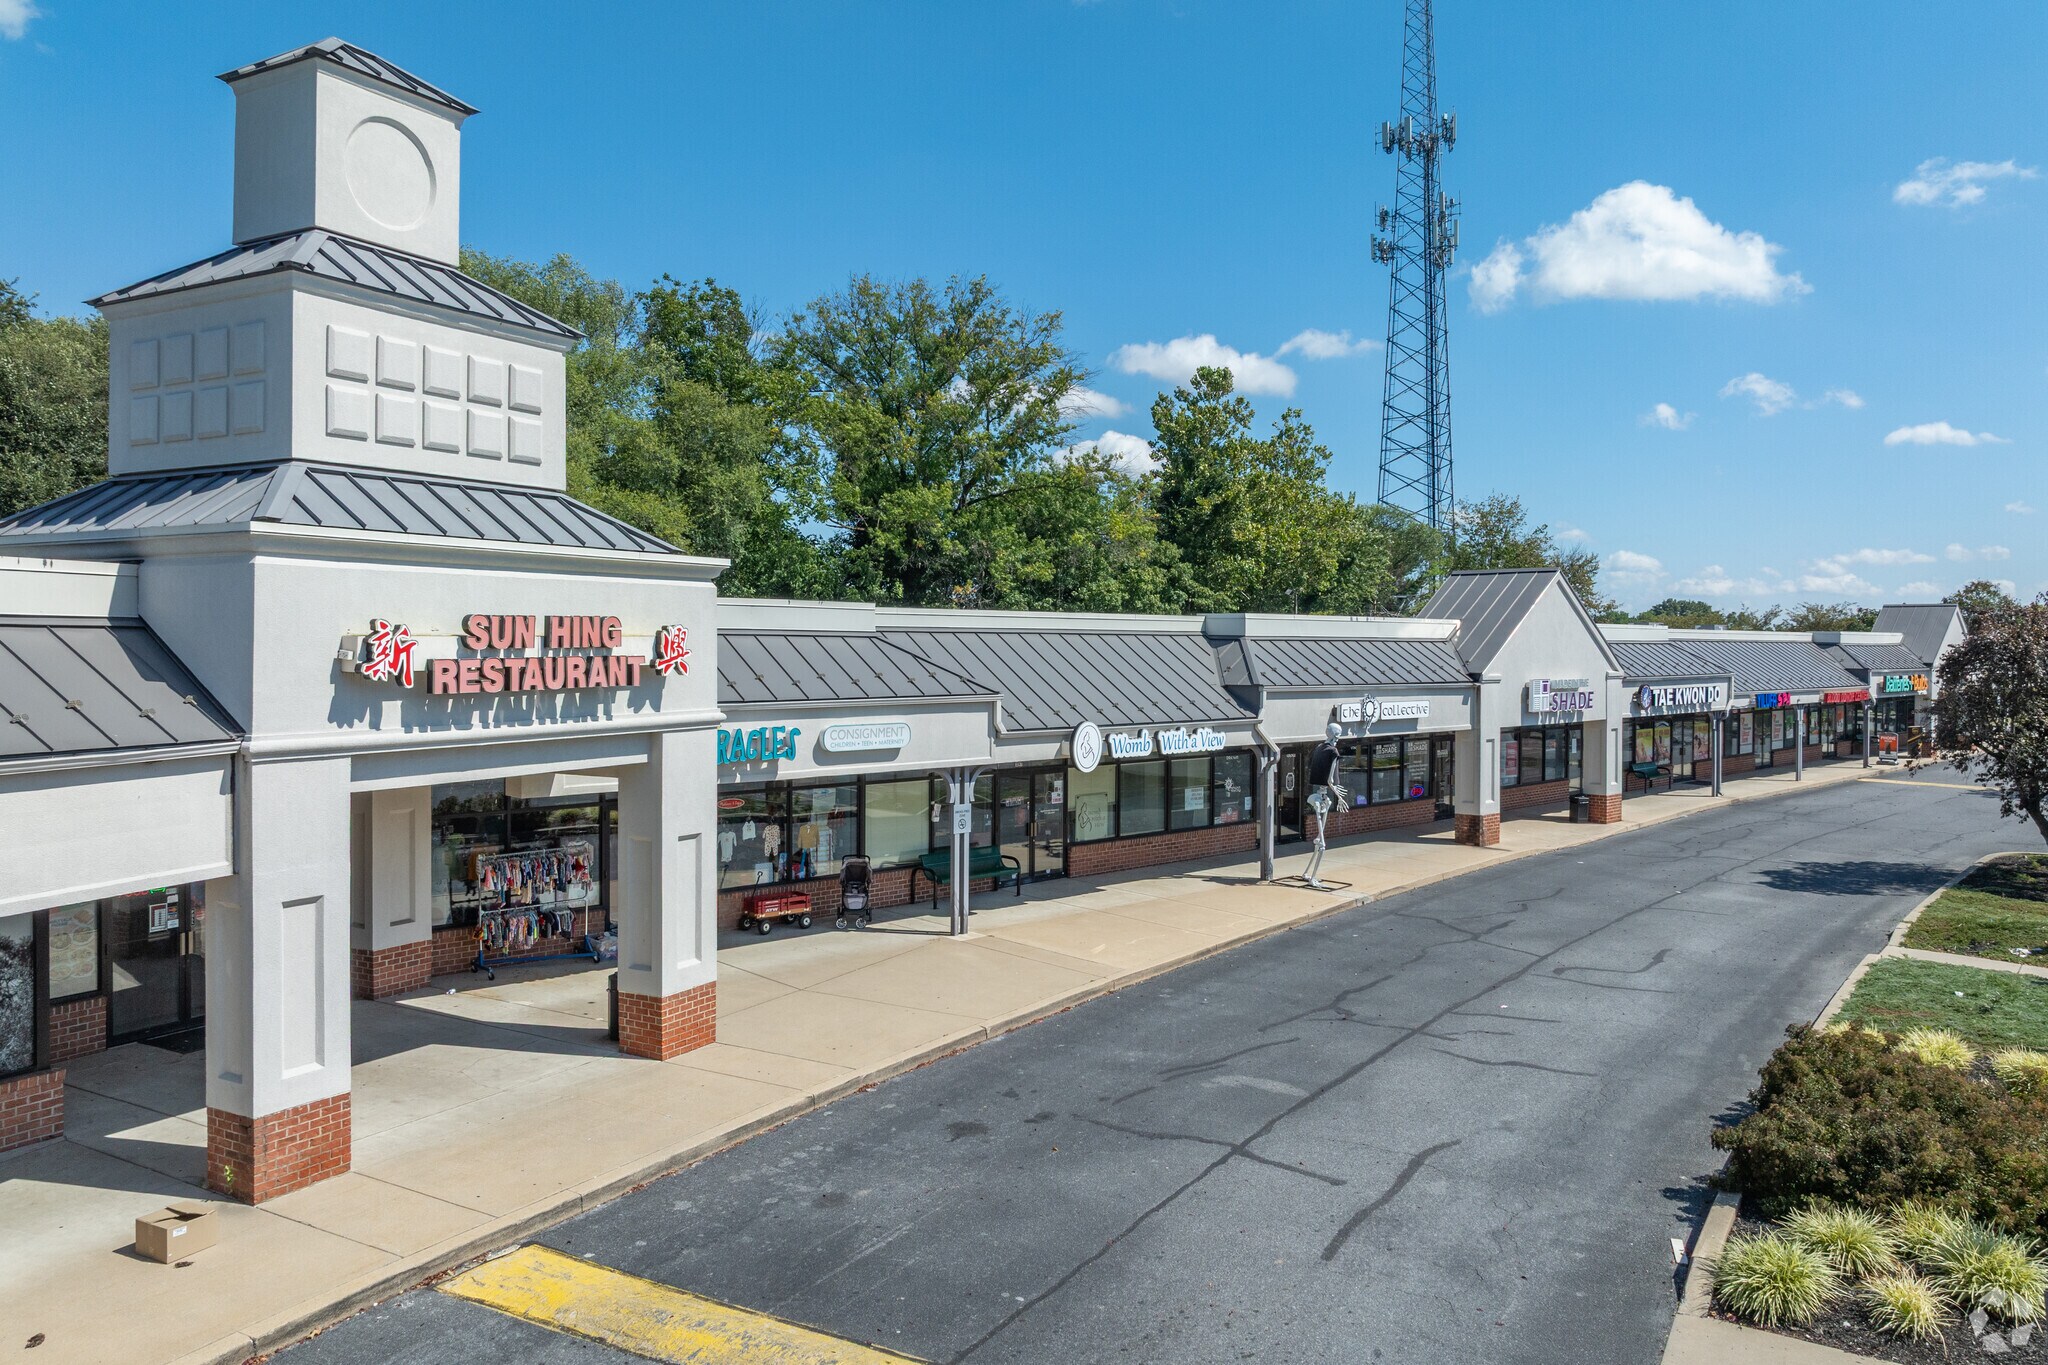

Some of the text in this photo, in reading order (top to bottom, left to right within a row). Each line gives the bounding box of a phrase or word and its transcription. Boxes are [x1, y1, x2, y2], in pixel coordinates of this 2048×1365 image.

[464, 614, 622, 651] SUN HING
[361, 618, 418, 689] 新
[427, 655, 646, 695] RESTAURANT
[1551, 691, 1594, 711] SHADE
[1653, 686, 1720, 707] TAE KWON DO
[717, 725, 801, 766] RACLES
[829, 726, 905, 741] CONSIGNMENT
[830, 741, 856, 749] CHILDREN
[1112, 730, 1226, 754] Womb With a View
